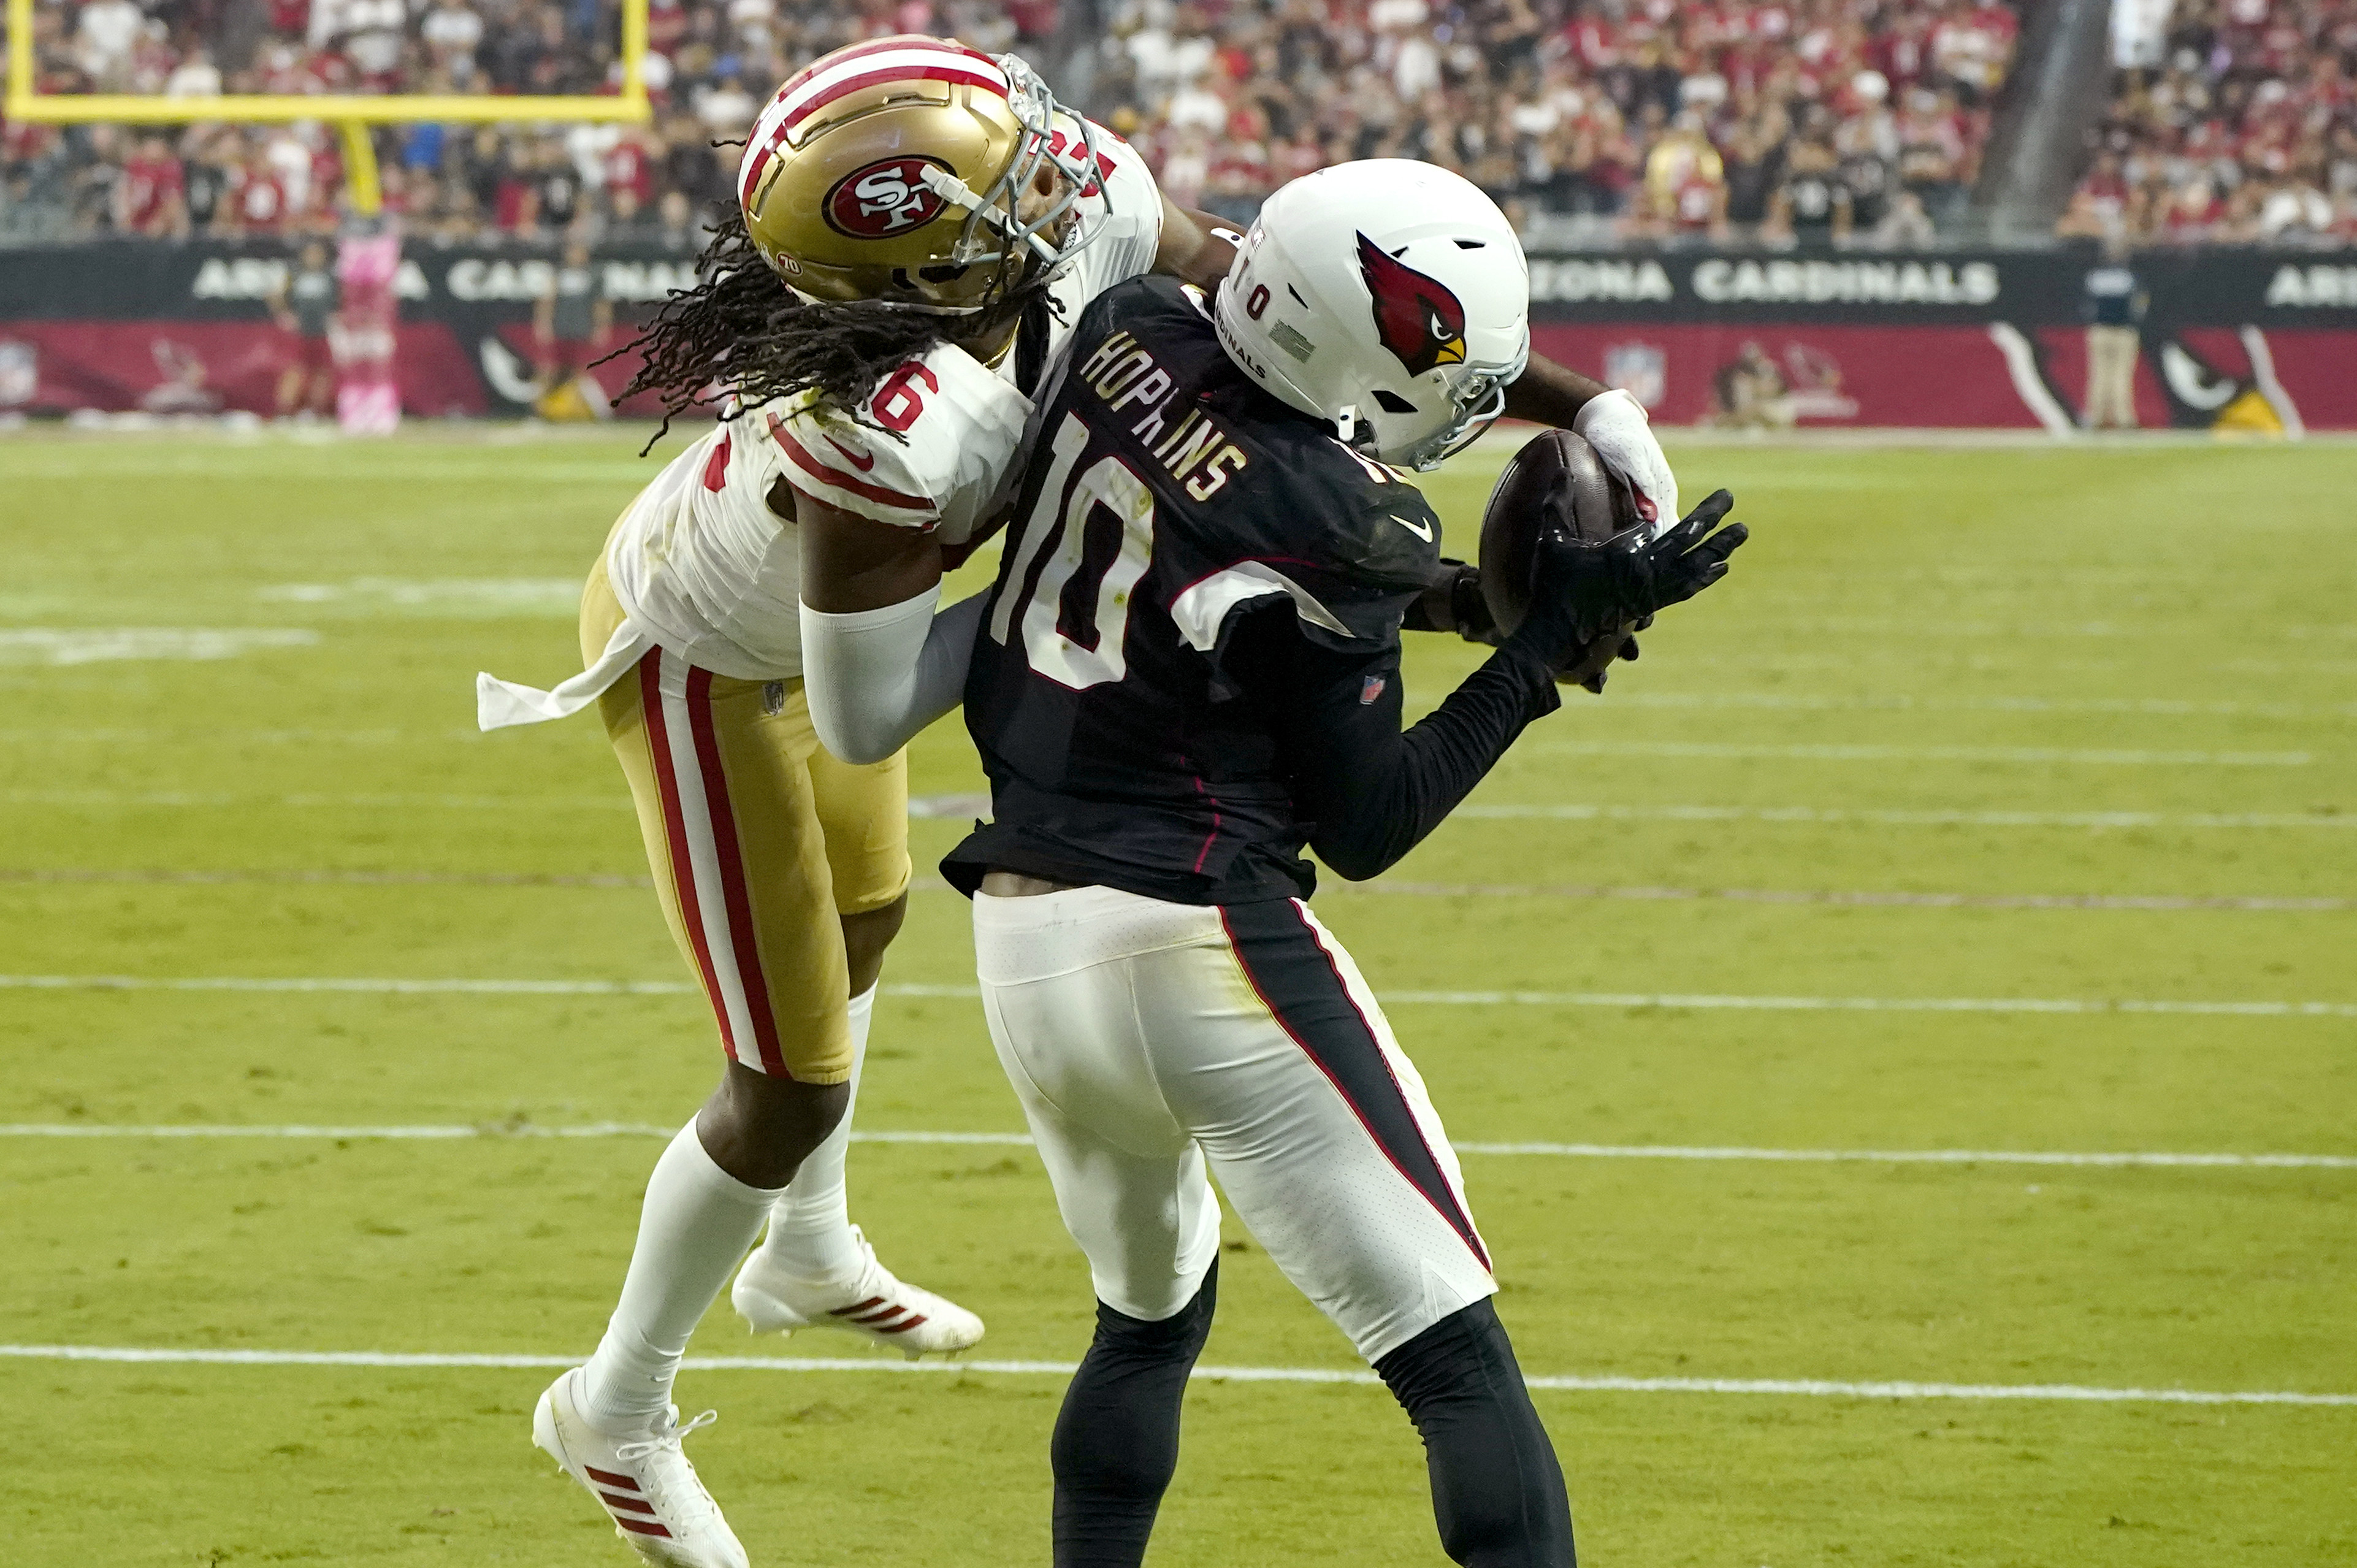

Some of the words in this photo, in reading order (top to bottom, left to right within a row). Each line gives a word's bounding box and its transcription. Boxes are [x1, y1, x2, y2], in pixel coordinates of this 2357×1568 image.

[1690, 260, 2000, 304] CARDINALS
[1079, 329, 1249, 503] HOPKINS
[989, 409, 1155, 692] 10
